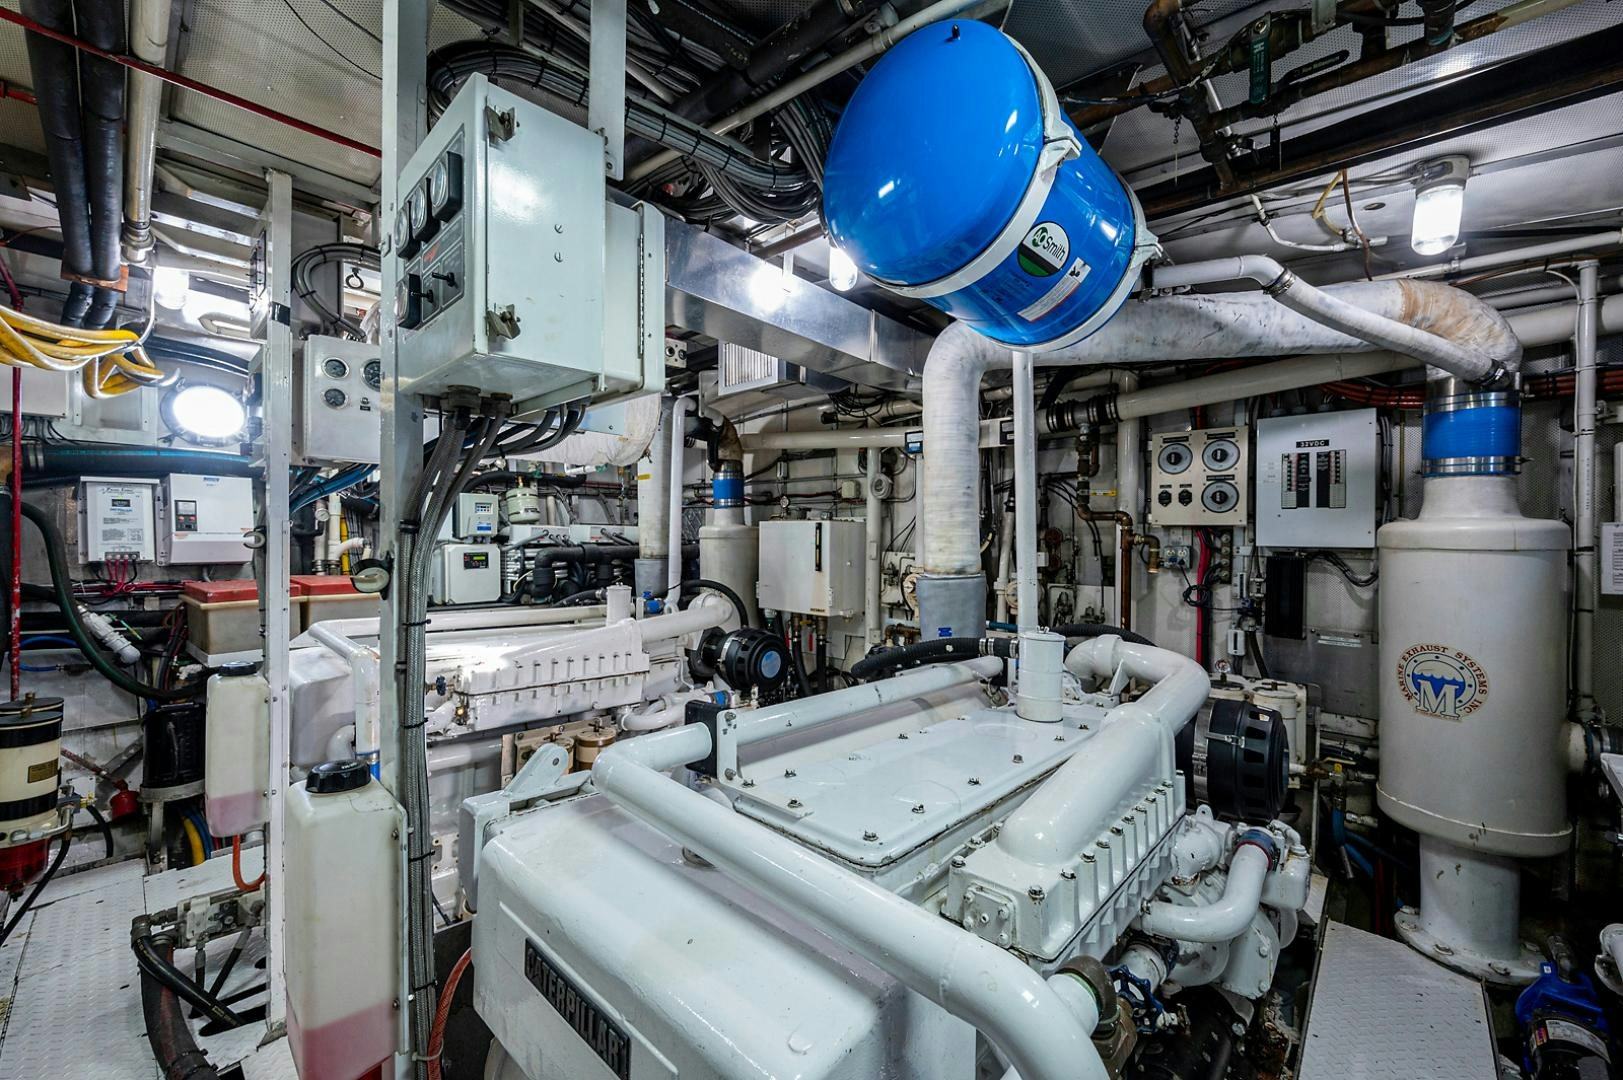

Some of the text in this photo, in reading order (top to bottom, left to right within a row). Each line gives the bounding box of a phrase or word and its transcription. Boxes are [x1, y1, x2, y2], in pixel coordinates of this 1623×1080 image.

[1043, 236, 1066, 261] Smith
[1397, 644, 1488, 714] MARINE EXHAUST SYSTEMS INC.
[527, 948, 619, 1071] CATERPILLAR
